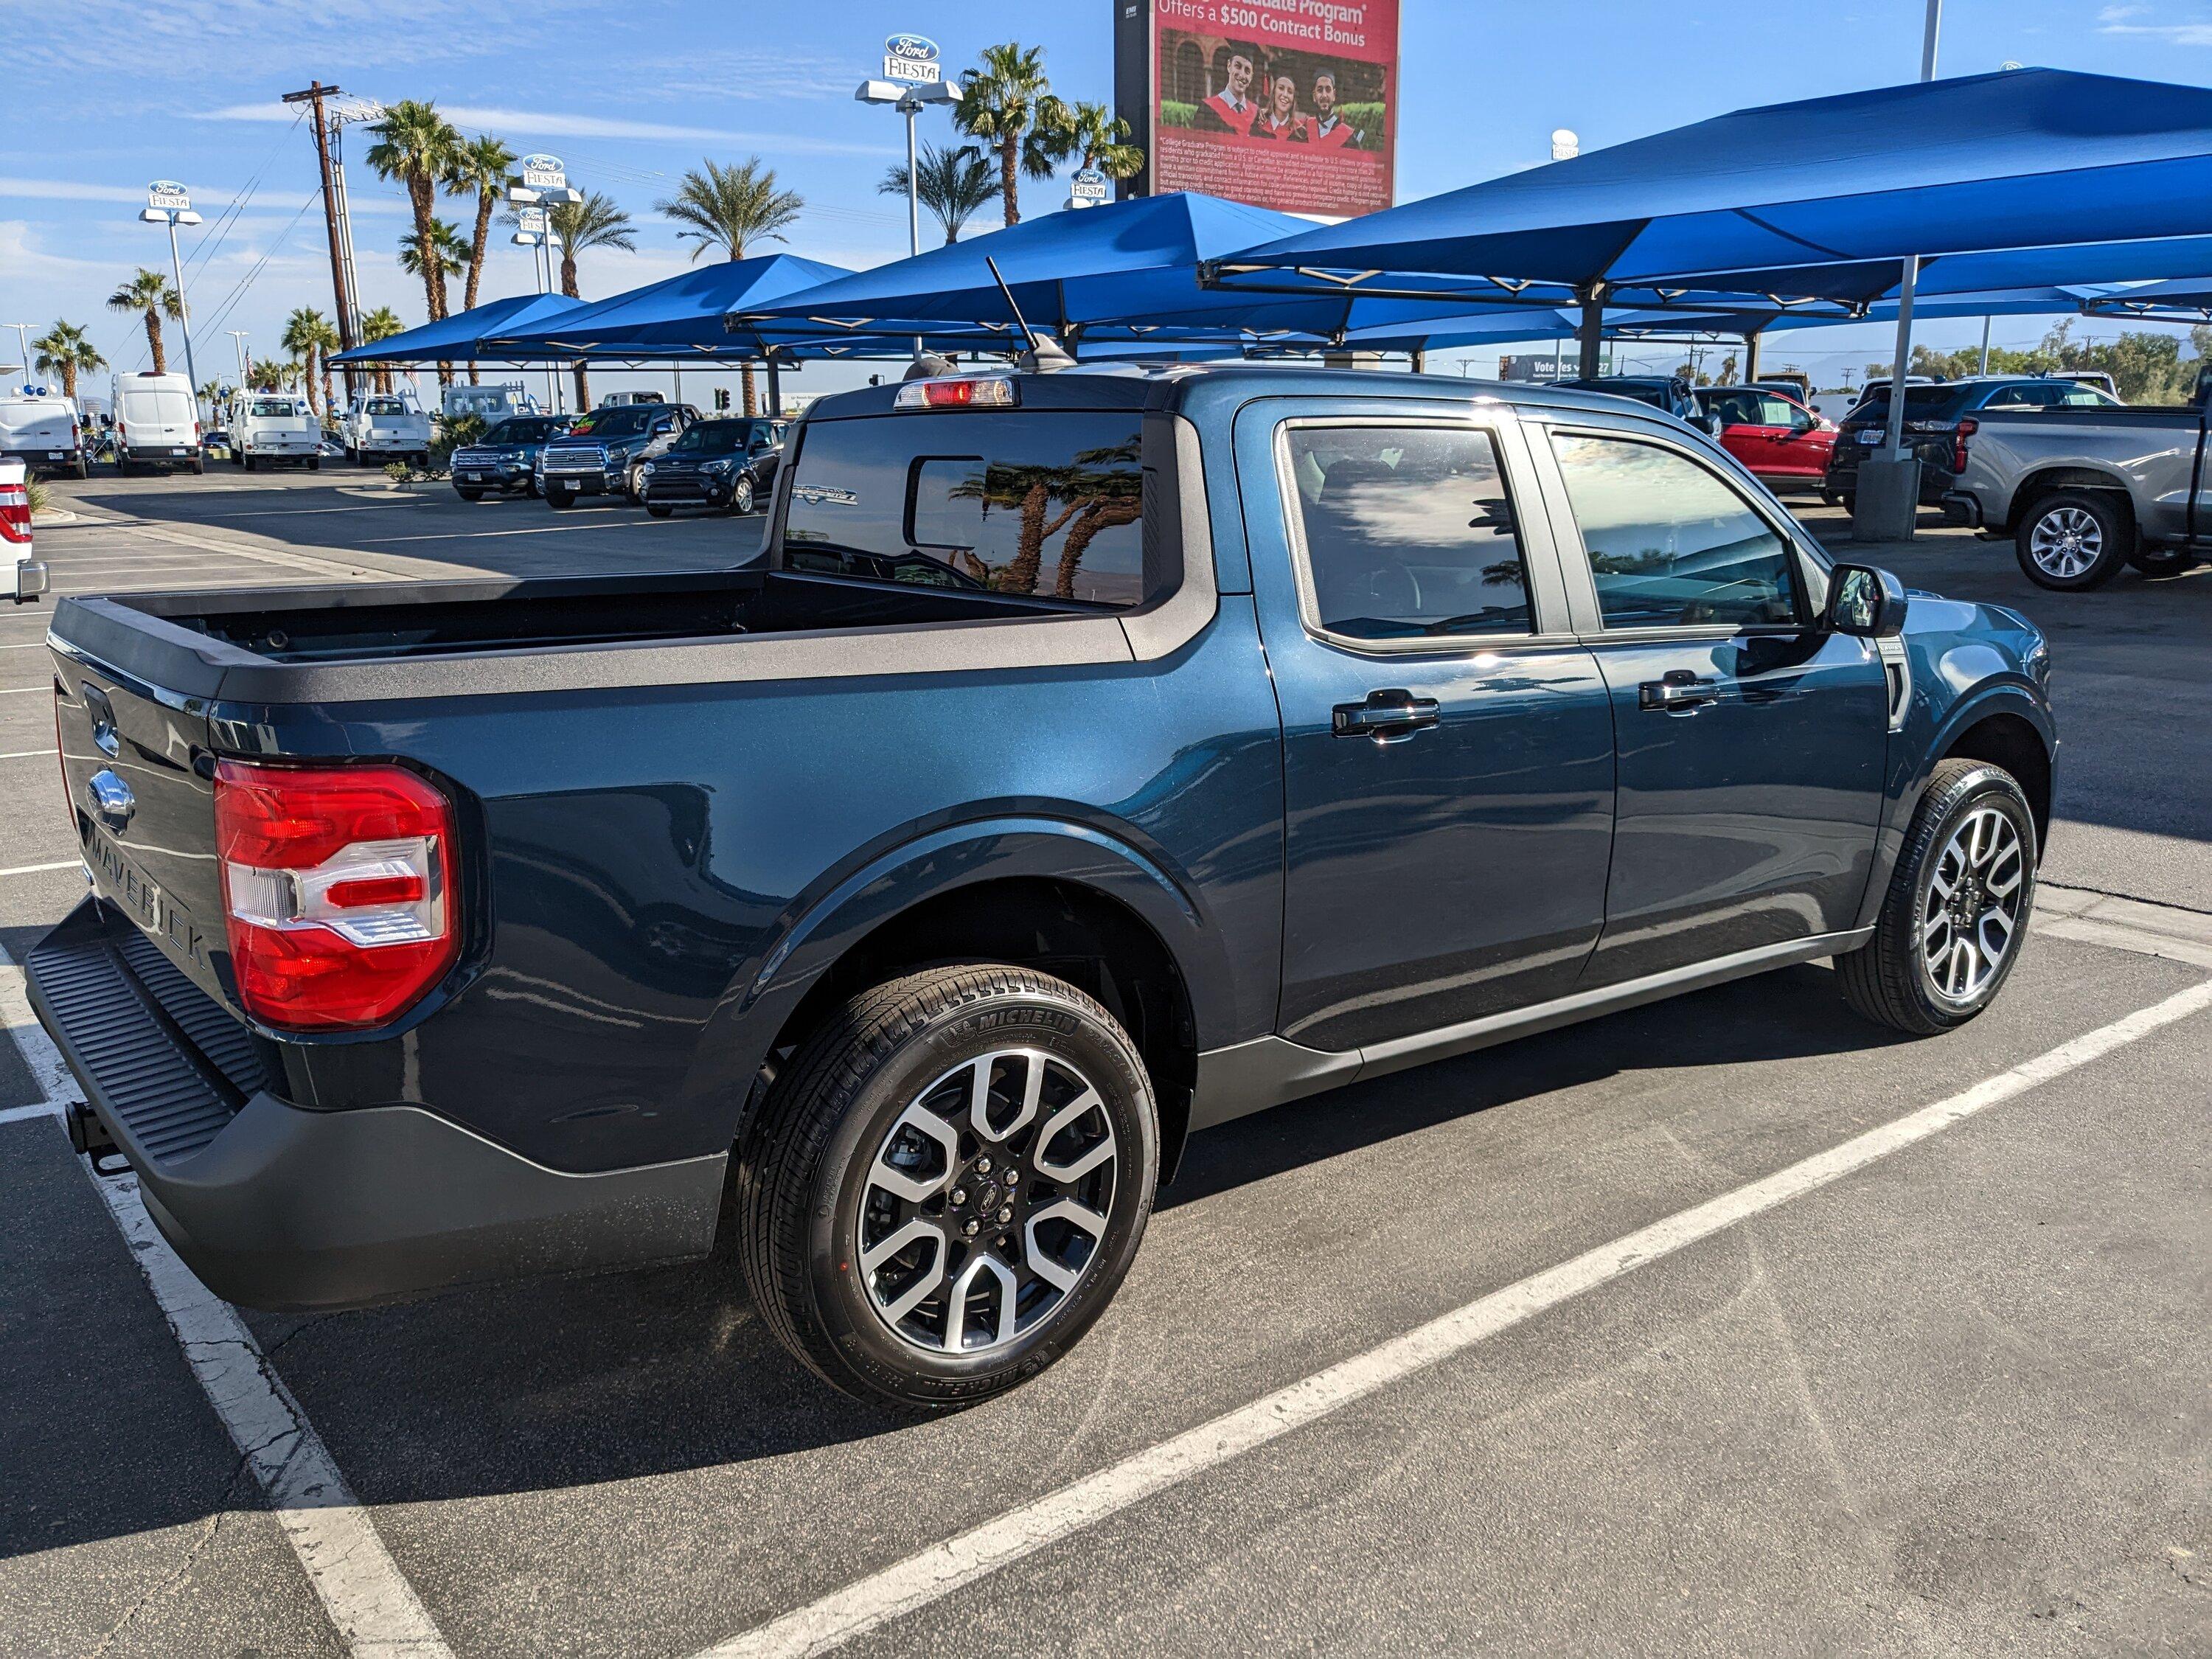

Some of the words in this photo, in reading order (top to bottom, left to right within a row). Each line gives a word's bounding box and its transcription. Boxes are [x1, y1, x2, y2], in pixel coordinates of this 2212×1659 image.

[1159, 0, 1204, 19] Offers
[1208, 7, 1216, 21] a
[1220, 4, 1257, 28] $500
[1261, 13, 1321, 40] Contract
[1324, 24, 1365, 46] Bonus
[895, 36, 929, 59] Ford
[888, 58, 936, 80] FIESTA
[531, 156, 556, 171] Ford
[526, 171, 563, 184] FIESTA
[1077, 170, 1099, 183] Ford
[156, 182, 181, 195] Ford
[1074, 184, 1104, 196] FIESTA
[152, 195, 187, 206] FIESTA
[1534, 361, 1554, 372] Vote
[1599, 363, 1608, 372] 27
[90, 824, 206, 971] MAVERICK
[979, 1009, 1077, 1034] MICHELIN
